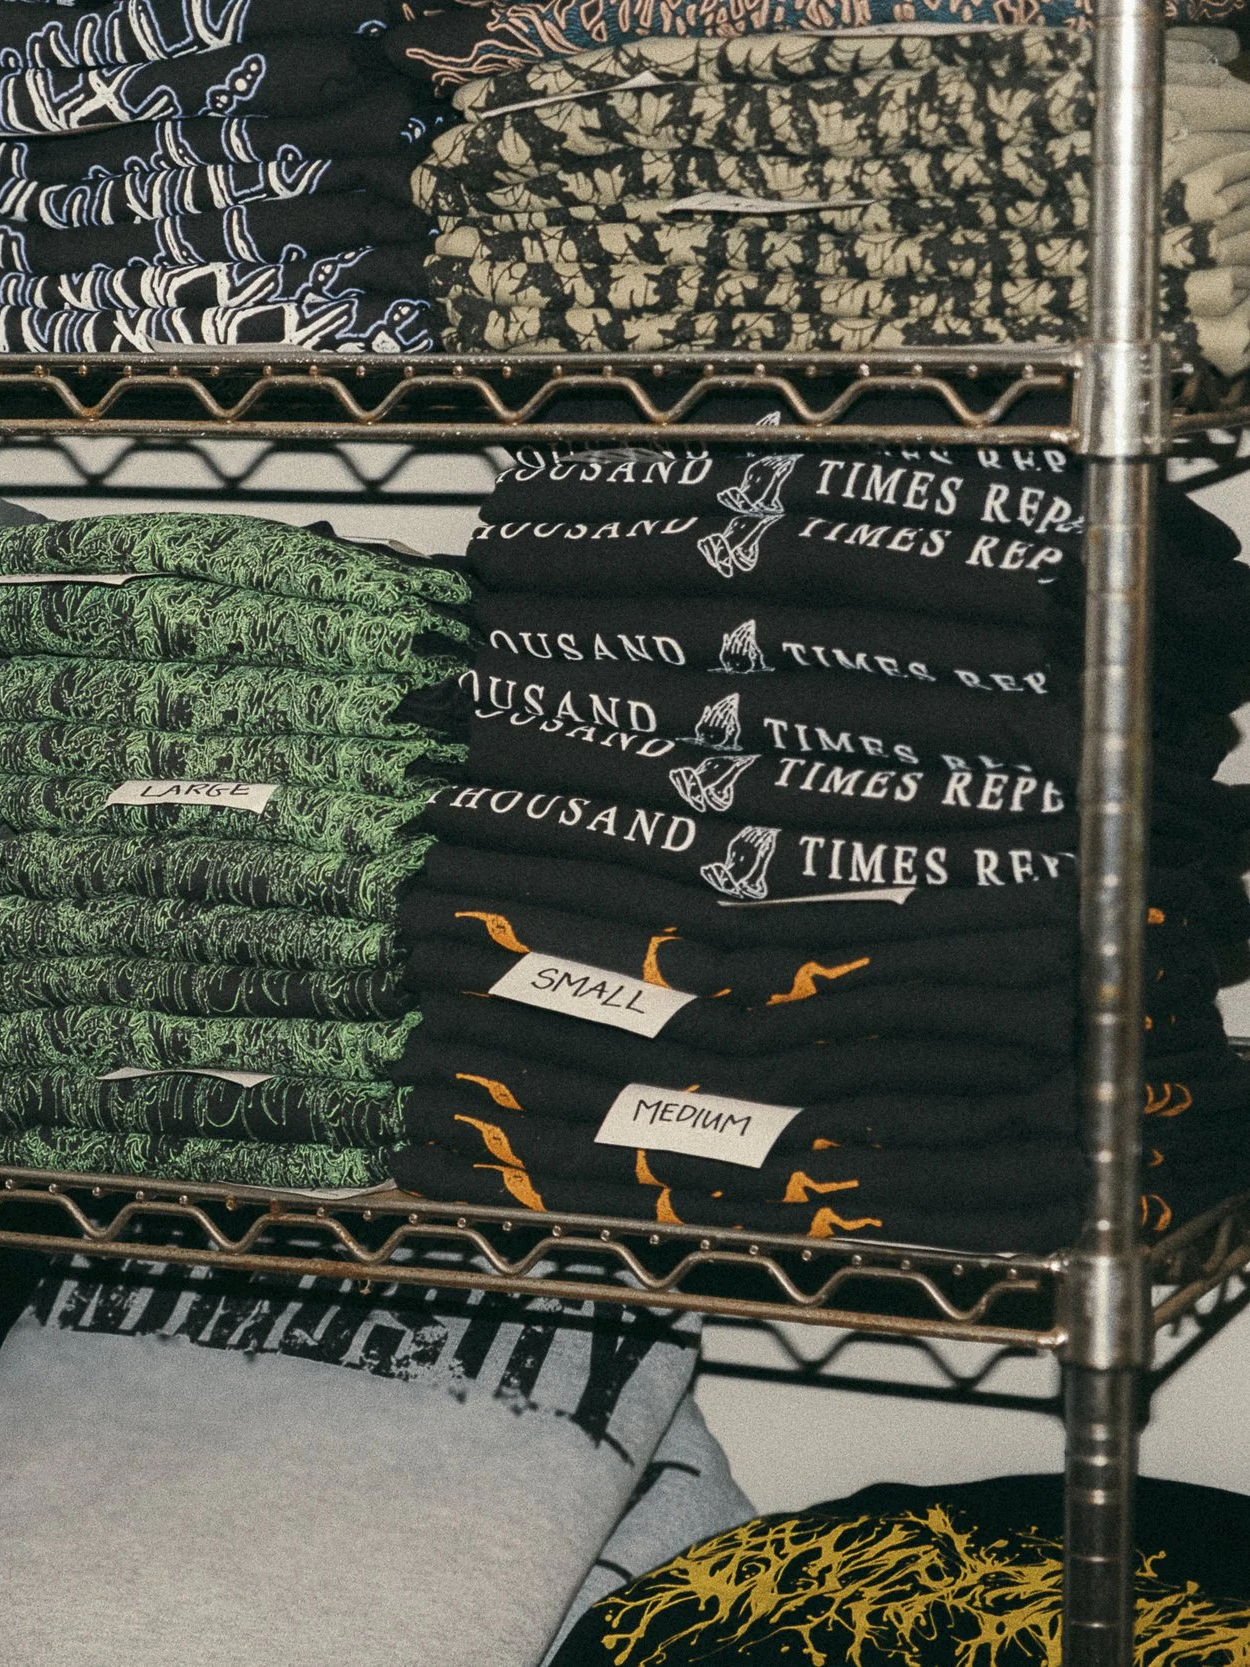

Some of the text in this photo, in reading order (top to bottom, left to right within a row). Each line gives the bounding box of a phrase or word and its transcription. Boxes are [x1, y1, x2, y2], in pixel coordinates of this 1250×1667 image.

[816, 459, 964, 516] TIMES
[799, 517, 952, 558] TIMES
[782, 642, 937, 681] TIMES
[763, 717, 919, 764] TIMES
[140, 783, 251, 798] LARGE
[775, 758, 924, 802] TIMES
[800, 836, 949, 886] TIMES
[531, 968, 646, 1015] SMALL
[633, 1099, 752, 1137] MEDIUM
